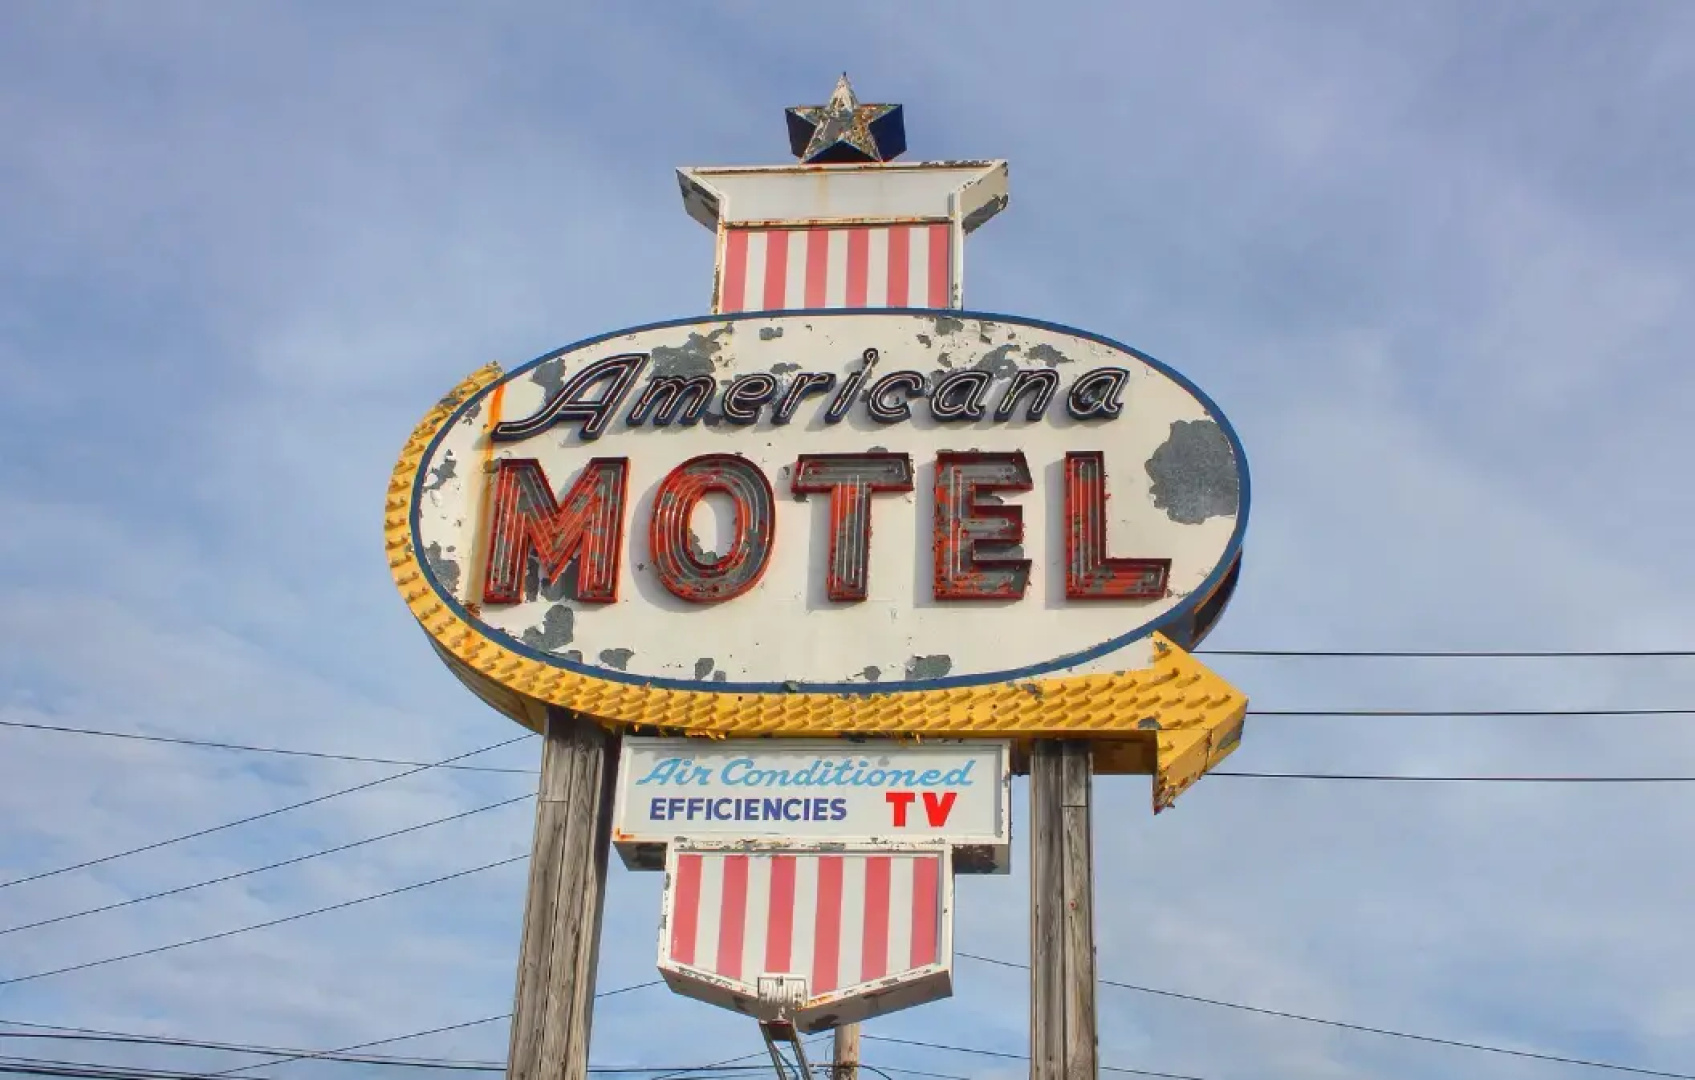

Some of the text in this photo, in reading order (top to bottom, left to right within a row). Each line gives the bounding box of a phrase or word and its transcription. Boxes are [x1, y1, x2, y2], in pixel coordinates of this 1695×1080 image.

[491, 347, 1130, 441] Americana
[483, 450, 1173, 604] MOTEL
[636, 757, 977, 788] Air Conditioned
[649, 791, 958, 828] EFFICIENCIES TV
